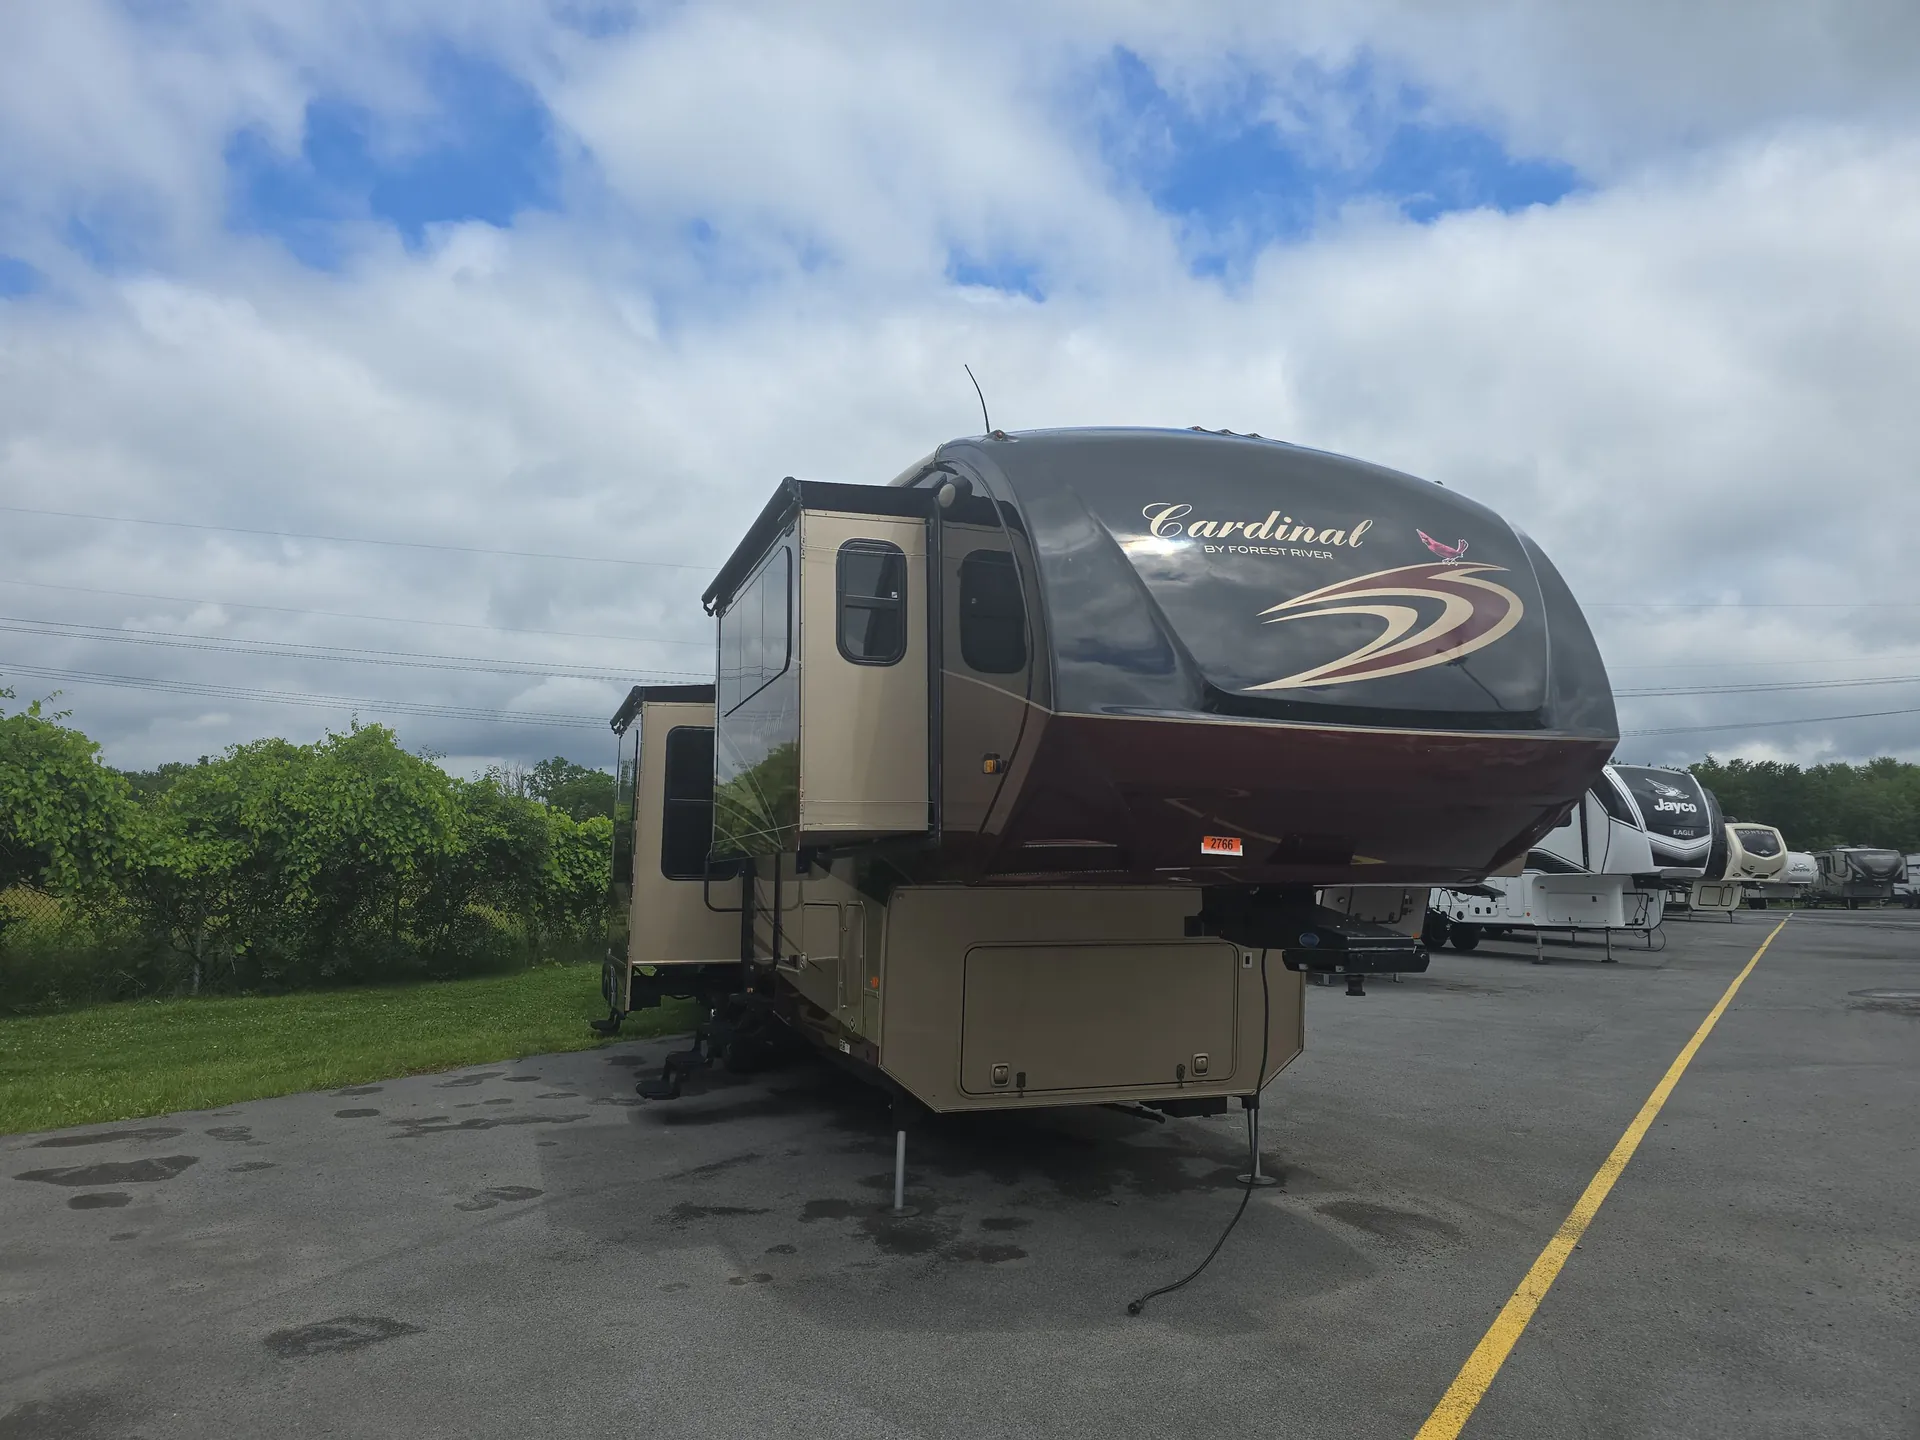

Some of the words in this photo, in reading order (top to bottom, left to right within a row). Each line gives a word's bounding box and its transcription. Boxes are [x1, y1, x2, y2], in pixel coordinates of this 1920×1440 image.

[1142, 502, 1373, 548] Cardinal
[1204, 545, 1225, 553] BY
[1228, 545, 1287, 556] FOREST
[1290, 548, 1334, 560] RIVER
[1654, 798, 1697, 814] Jayco
[1210, 837, 1234, 850] 2766
